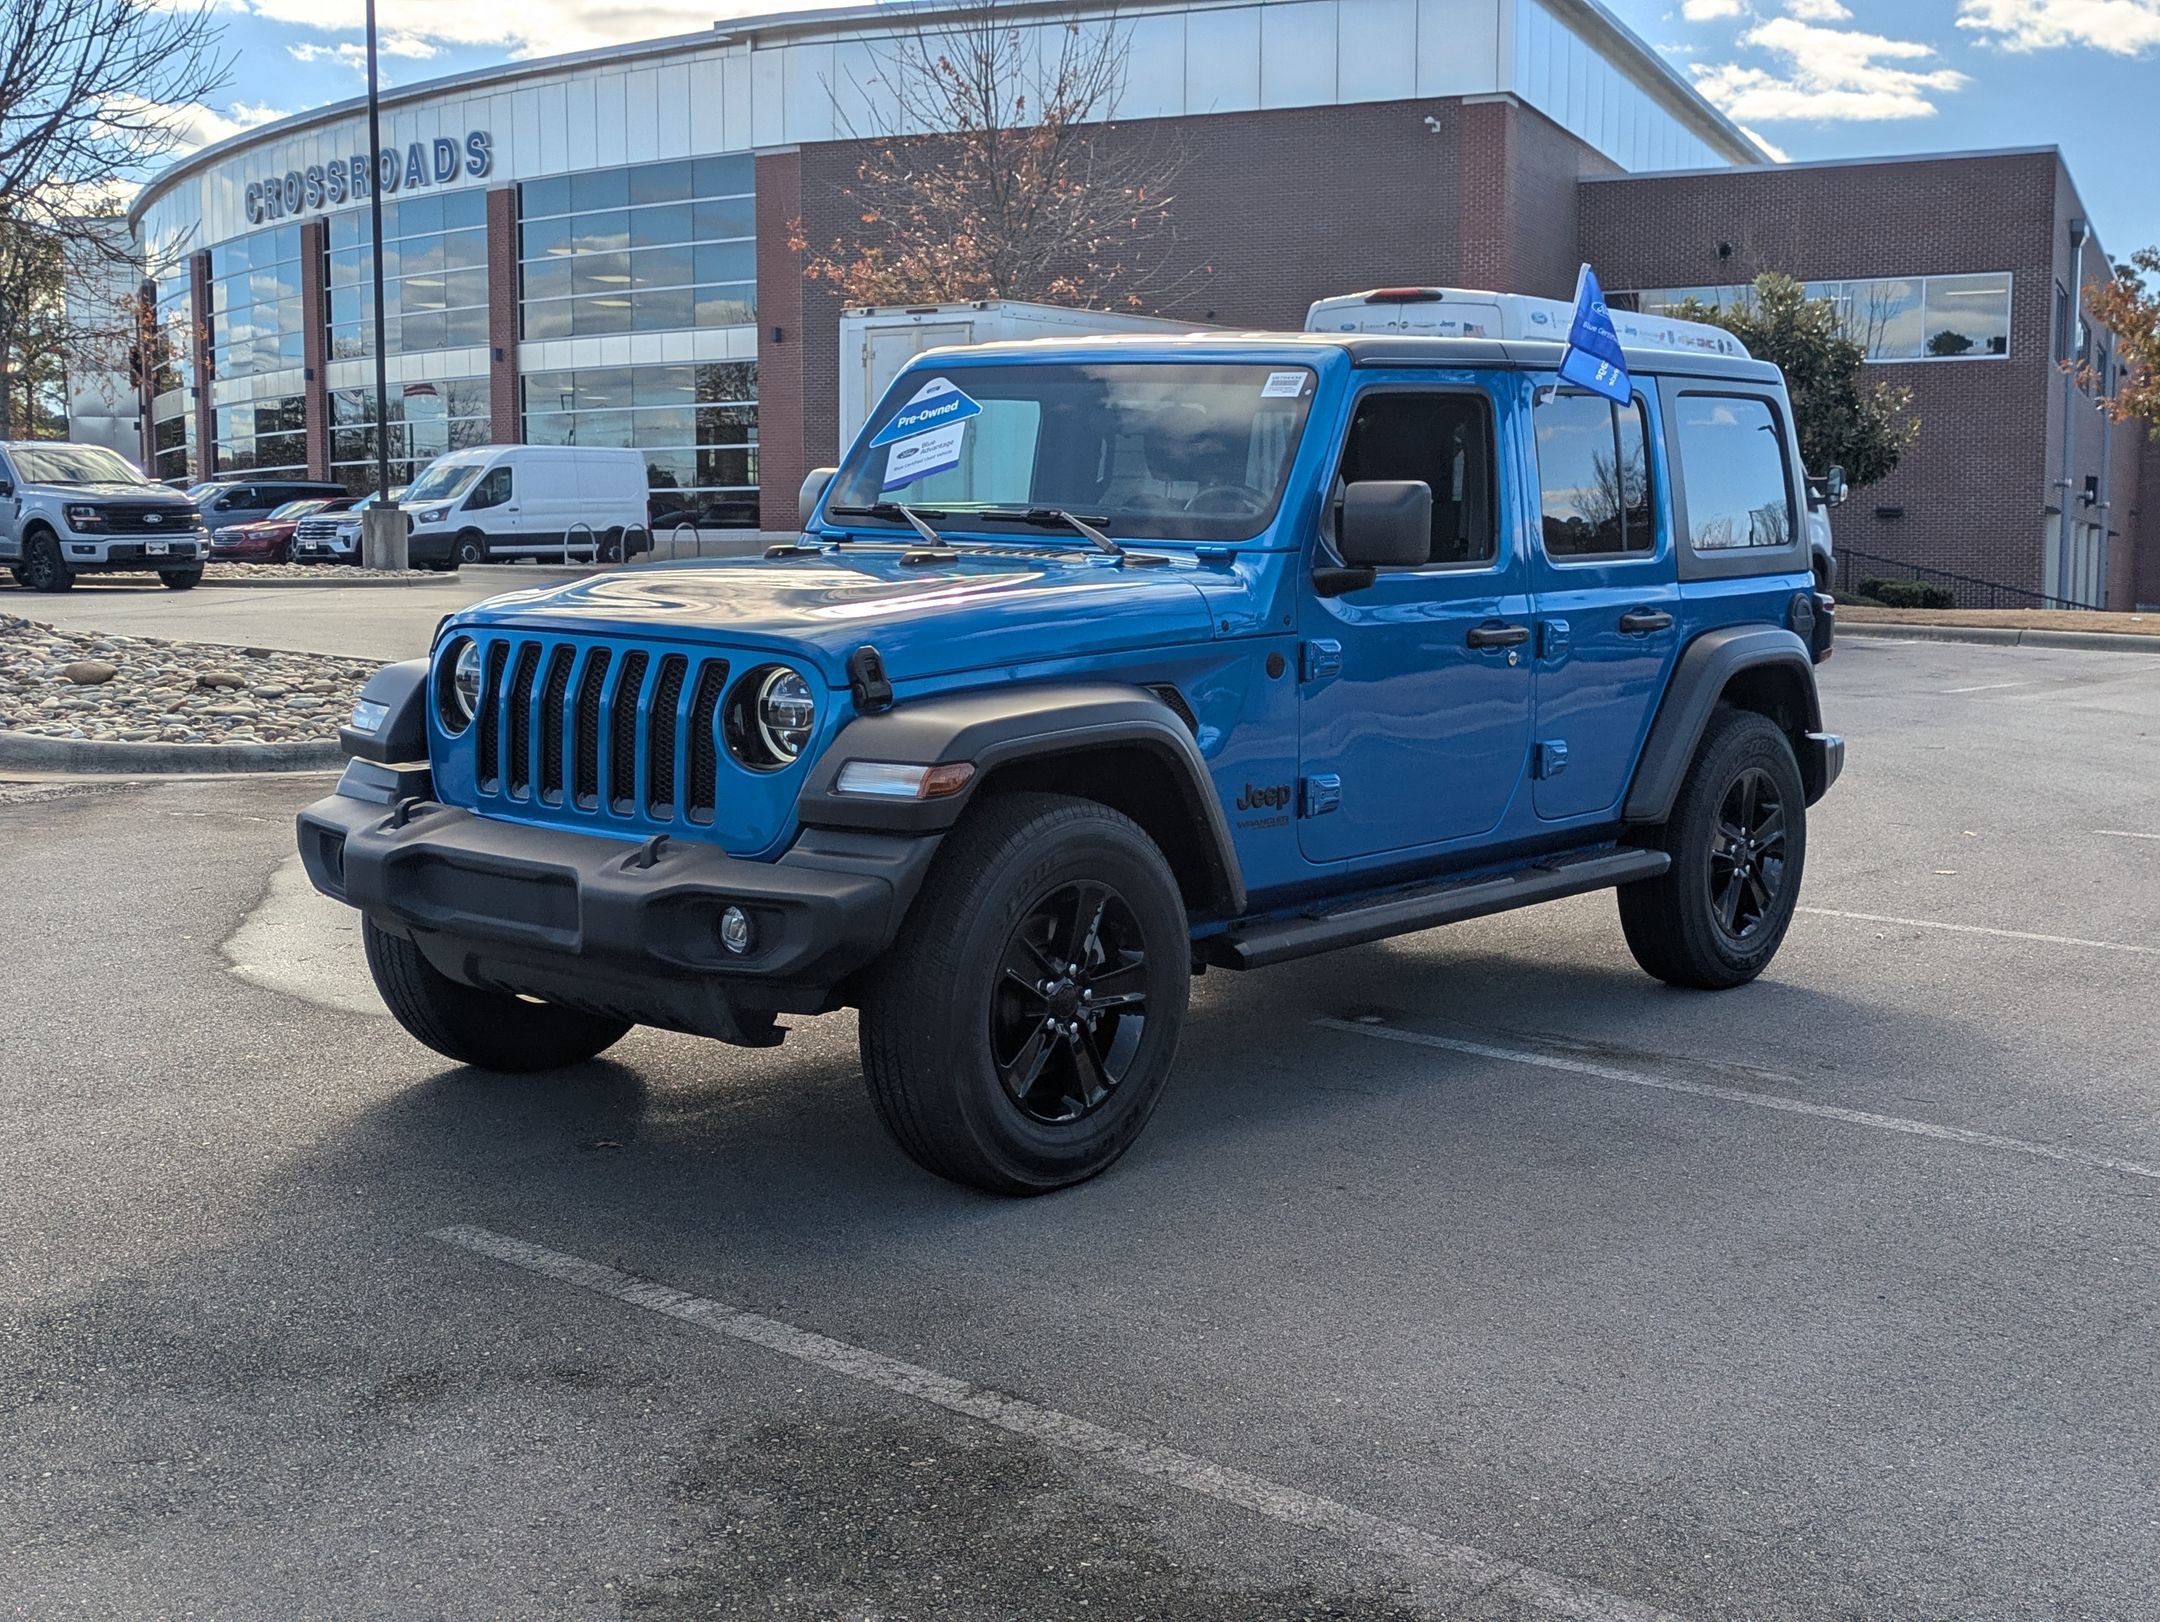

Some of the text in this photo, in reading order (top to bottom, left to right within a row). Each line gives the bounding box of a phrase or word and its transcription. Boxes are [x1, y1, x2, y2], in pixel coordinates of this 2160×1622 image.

[245, 130, 493, 224] CROSSROADS
[897, 400, 960, 428] Pre-Owned
[1236, 783, 1291, 811] Jeep
